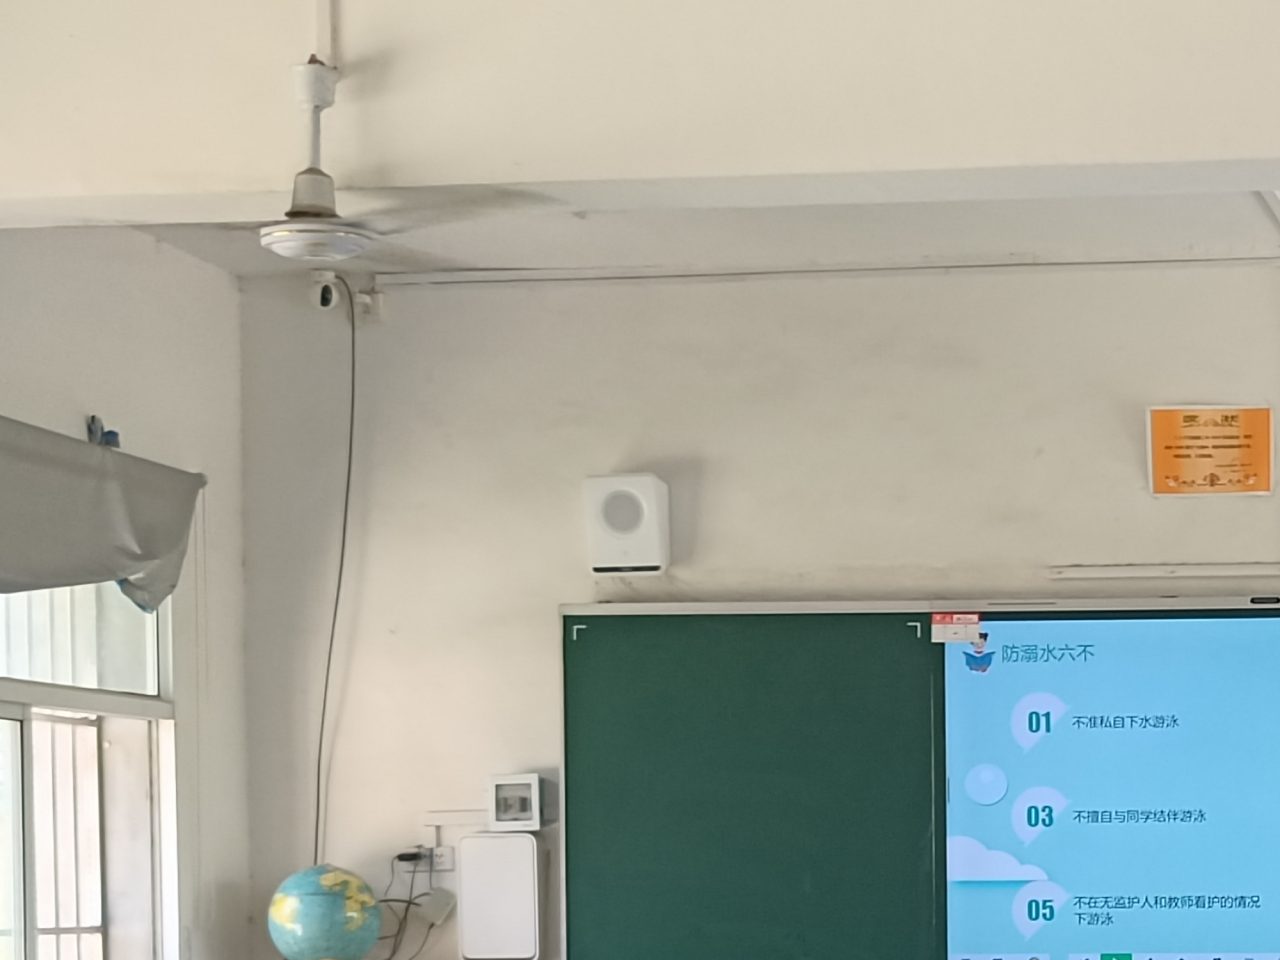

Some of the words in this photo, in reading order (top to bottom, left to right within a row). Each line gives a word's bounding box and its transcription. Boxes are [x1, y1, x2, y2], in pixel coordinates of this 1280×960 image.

[1001, 643, 1095, 664] 防溺水六不
[1027, 711, 1052, 733] 01
[1071, 714, 1180, 730] 不准私自下水游泳
[1026, 805, 1054, 828] 03
[1072, 808, 1208, 824] 不擅自与同学结伴游泳
[1026, 899, 1055, 922] 05
[1073, 895, 1261, 910] 不在无监护人和教师看护的情况
[1074, 911, 1114, 927] 下游泳
